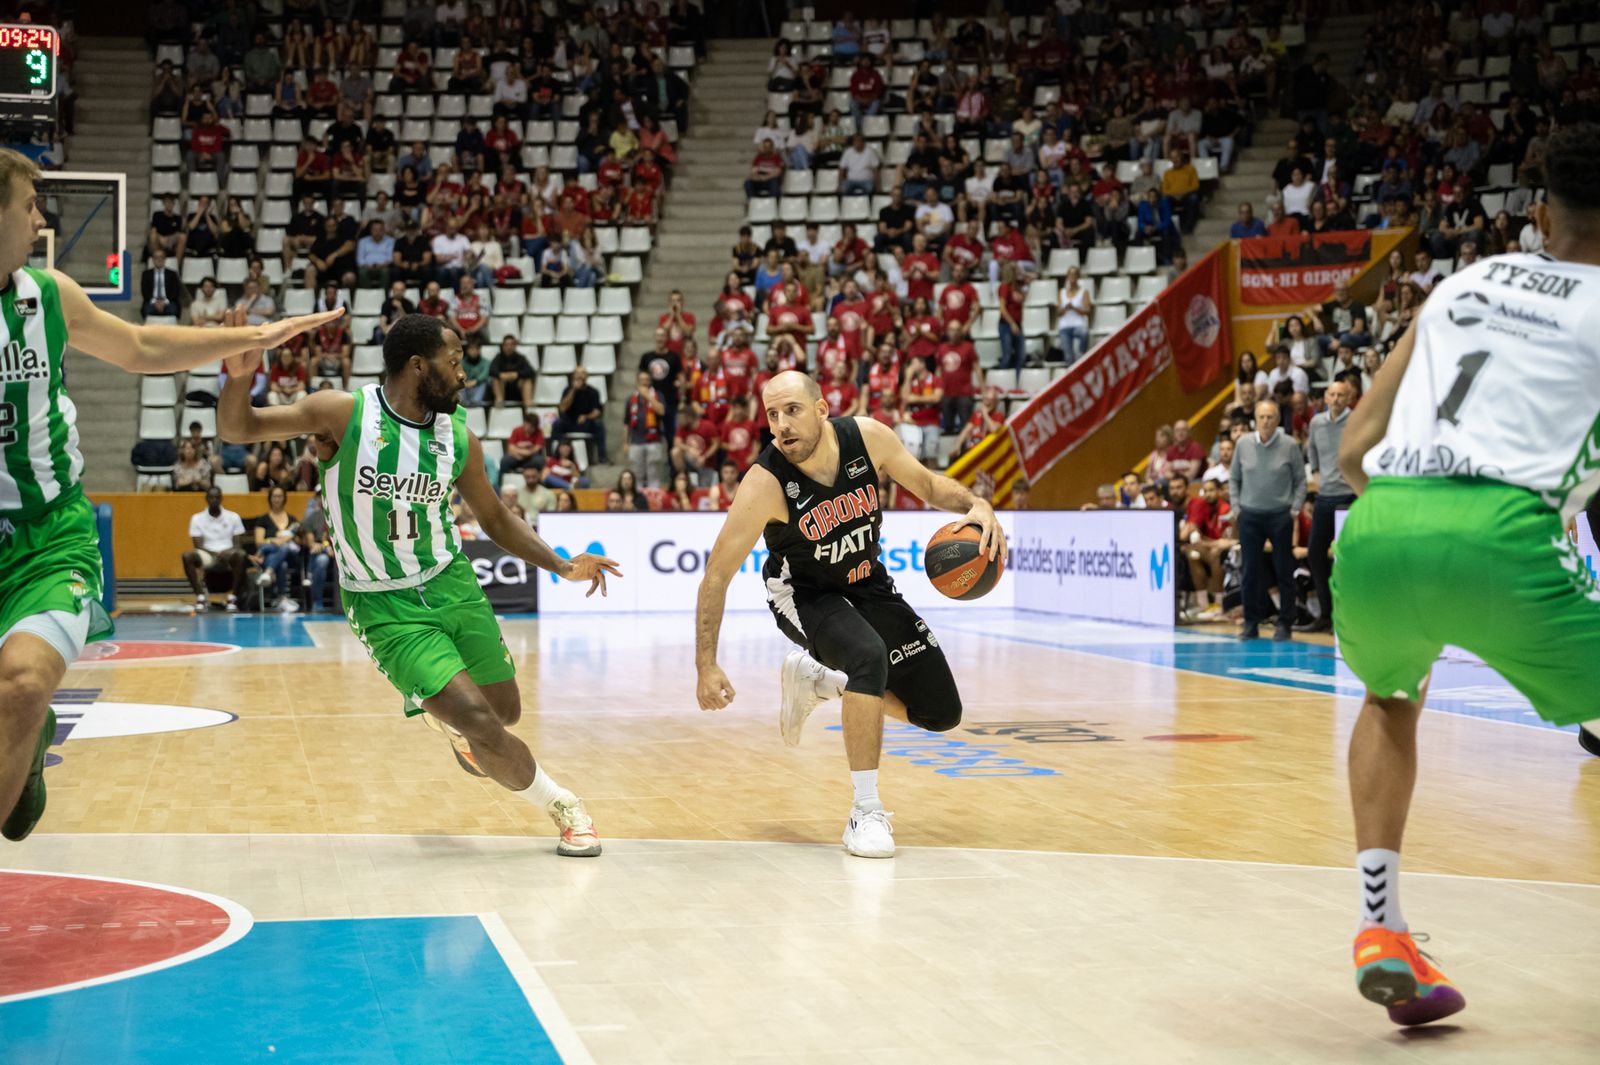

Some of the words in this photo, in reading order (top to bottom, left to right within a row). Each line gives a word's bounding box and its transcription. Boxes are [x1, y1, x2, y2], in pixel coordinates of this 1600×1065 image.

[0, 28, 52, 49] 09:24
[26, 49, 48, 85] 9
[1482, 262, 1582, 299] TYSON
[1018, 314, 1164, 460] ENGAVIATS
[1436, 350, 1491, 427] 1
[358, 465, 445, 498] Sevilla.
[387, 509, 419, 541] 11
[798, 484, 879, 541] GIRONA
[846, 560, 872, 584] 10
[1016, 537, 1053, 574] decides
[1055, 537, 1076, 585] qué
[1078, 540, 1137, 578] necesitas.
[902, 640, 921, 652] Kave
[904, 644, 927, 658] Home
